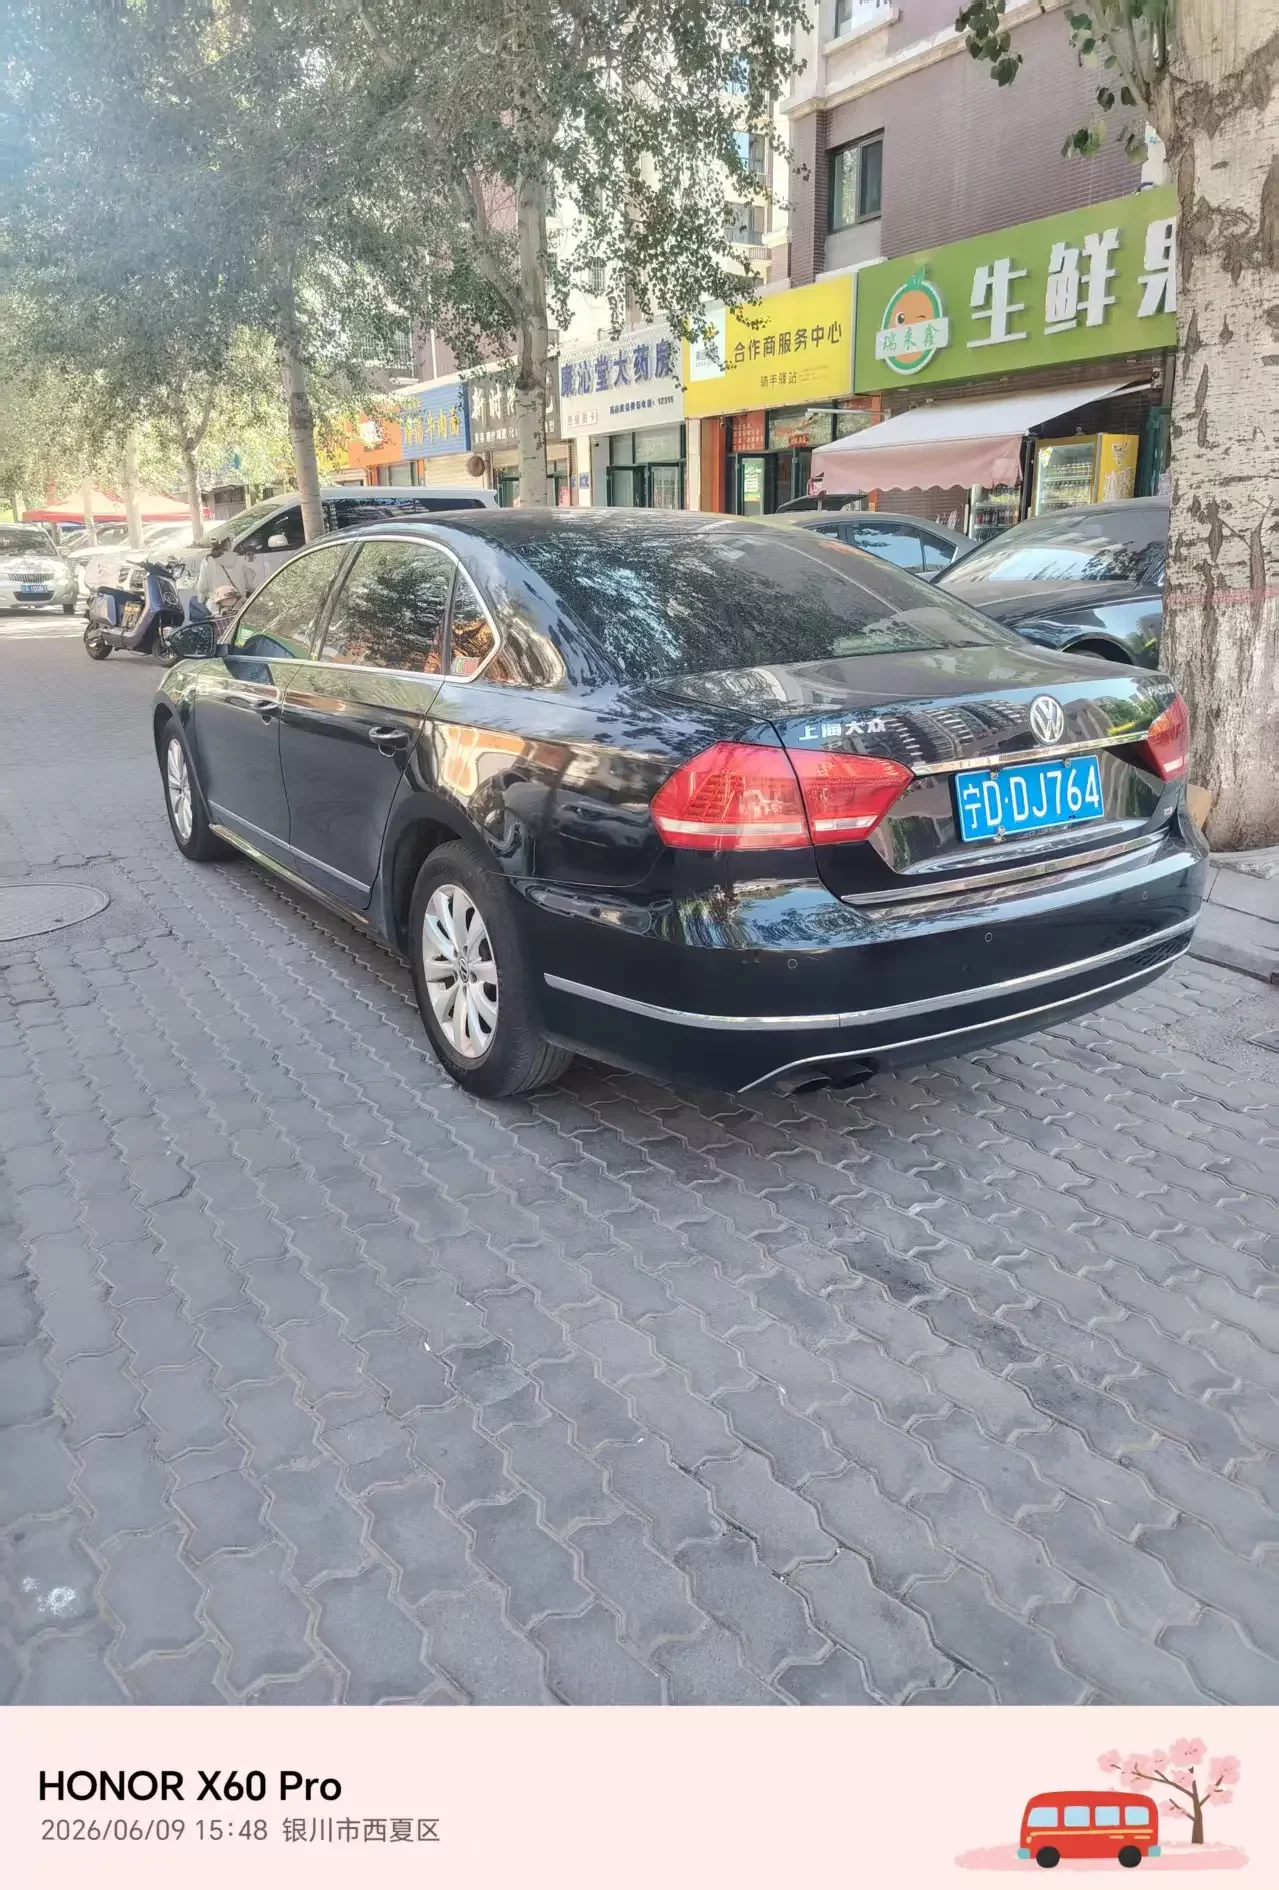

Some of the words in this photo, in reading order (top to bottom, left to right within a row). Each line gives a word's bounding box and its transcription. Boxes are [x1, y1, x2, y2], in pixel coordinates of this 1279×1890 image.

[966, 216, 1176, 349] 生鲜果
[733, 321, 842, 363] 合作商服务中心
[760, 371, 797, 388] 骑手驿站
[798, 717, 887, 741] 上海大众
